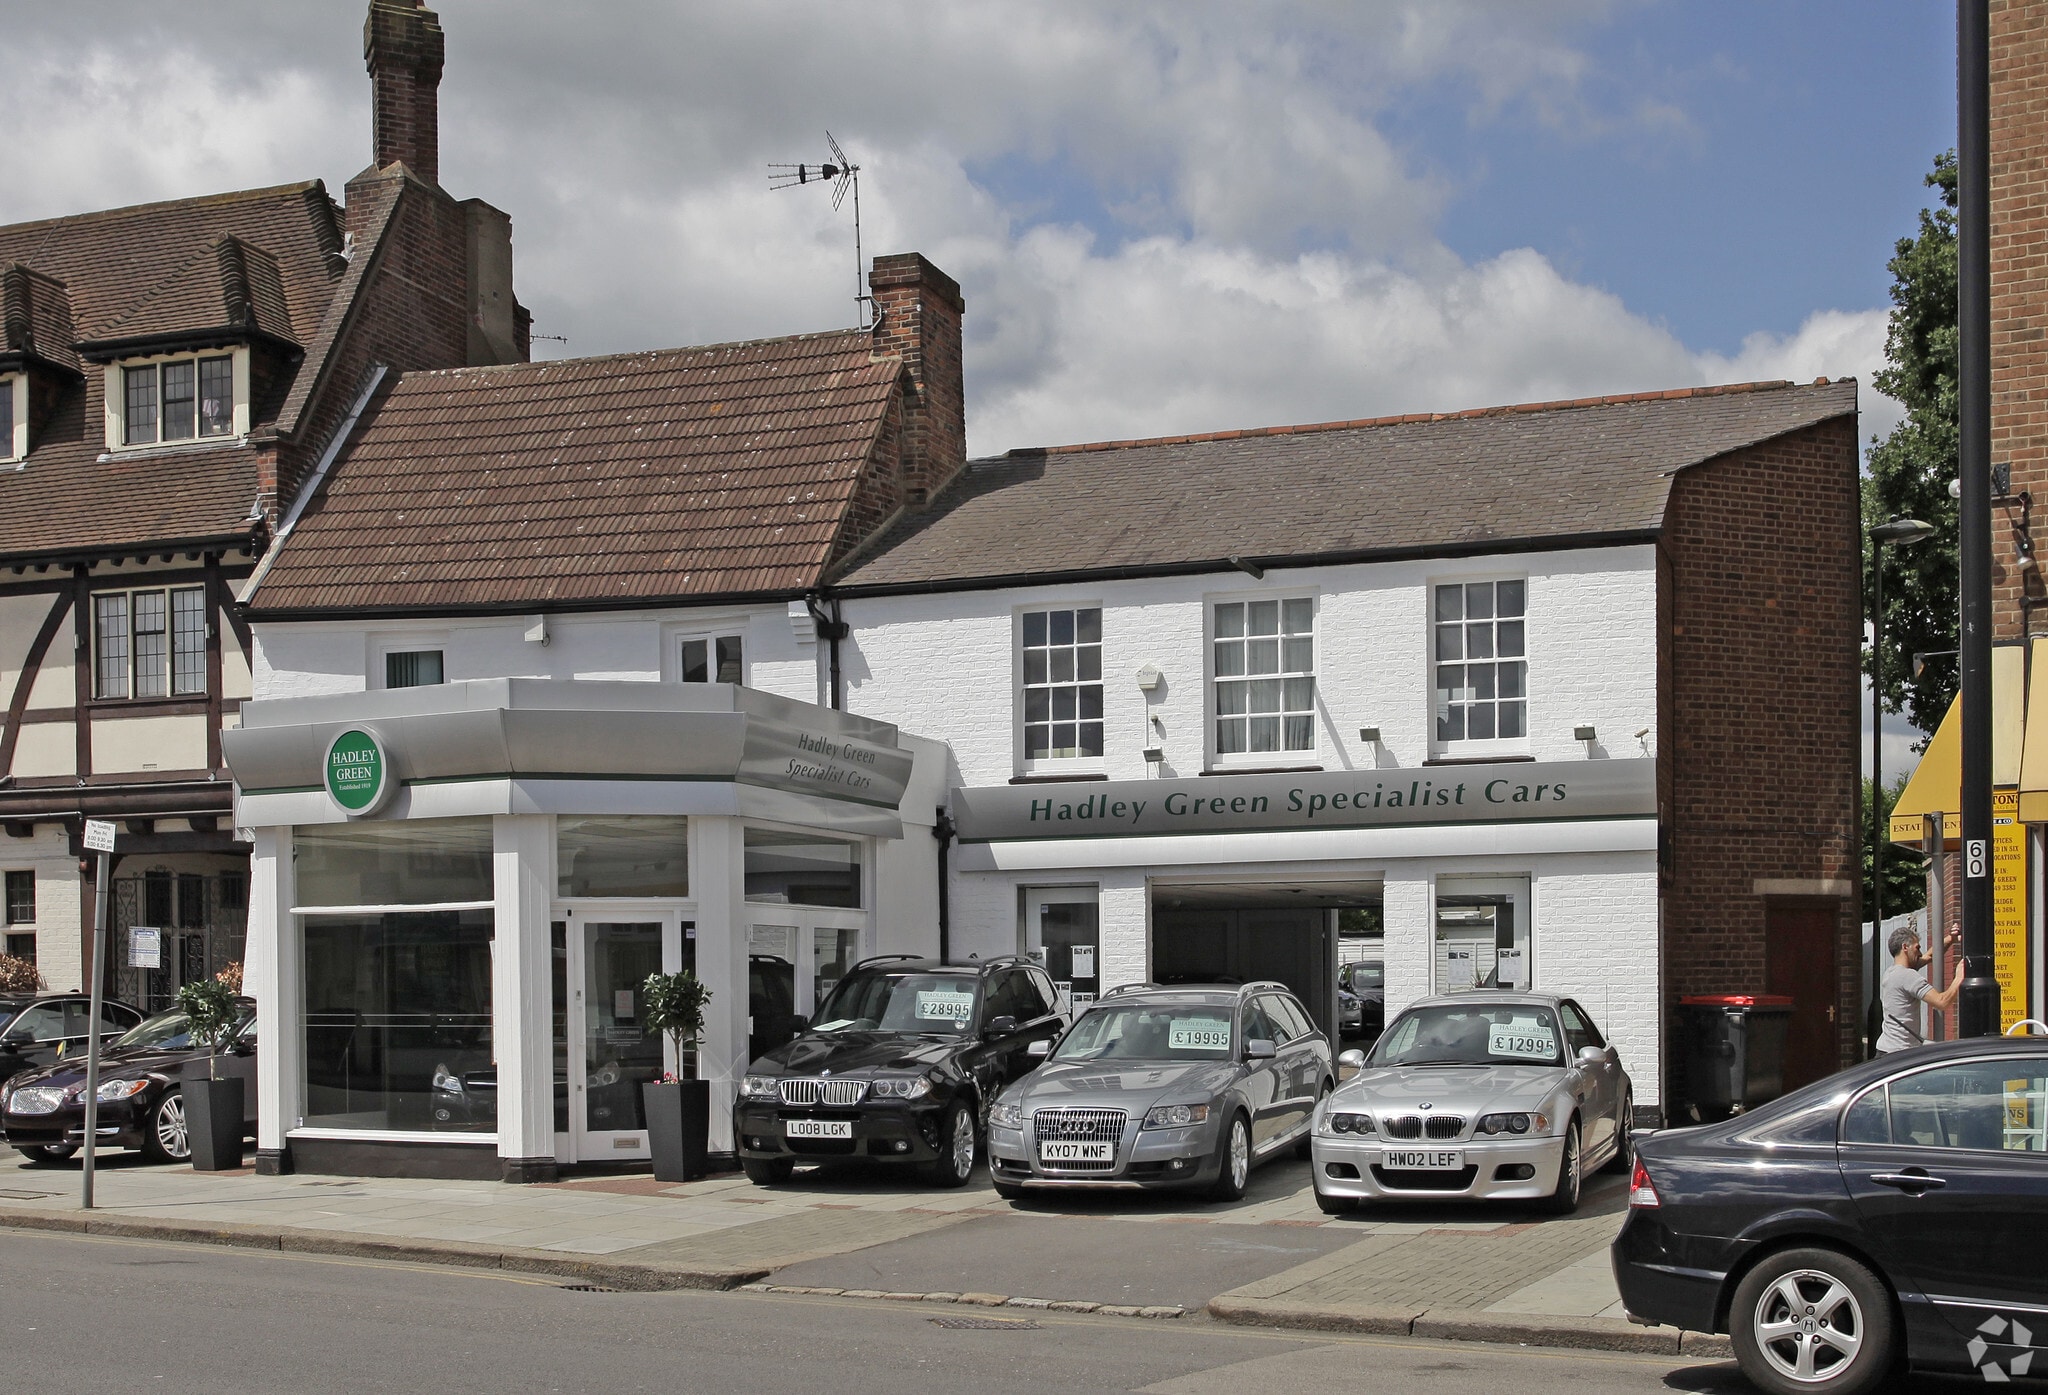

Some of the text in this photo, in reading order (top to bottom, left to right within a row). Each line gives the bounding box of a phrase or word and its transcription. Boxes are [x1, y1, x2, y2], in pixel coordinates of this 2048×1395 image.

[798, 733, 875, 764] Hadley Green
[333, 750, 375, 763] HADLEY
[336, 767, 372, 780] GREEN
[785, 758, 872, 789] Specialist Cars
[1030, 779, 1566, 824] Hadley Green Specialist Cars
[1993, 795, 2018, 804] TON
[1893, 824, 1922, 832] ESTAT
[921, 1002, 969, 1016] £28995
[1528, 1026, 1551, 1034] GREEN
[1174, 1031, 1229, 1045] £19995
[1494, 1036, 1554, 1053] £12995
[791, 1123, 846, 1135] LO08 LGK
[1046, 1144, 1107, 1158] KY07 WNF
[1388, 1152, 1456, 1166] HW02 LEF
